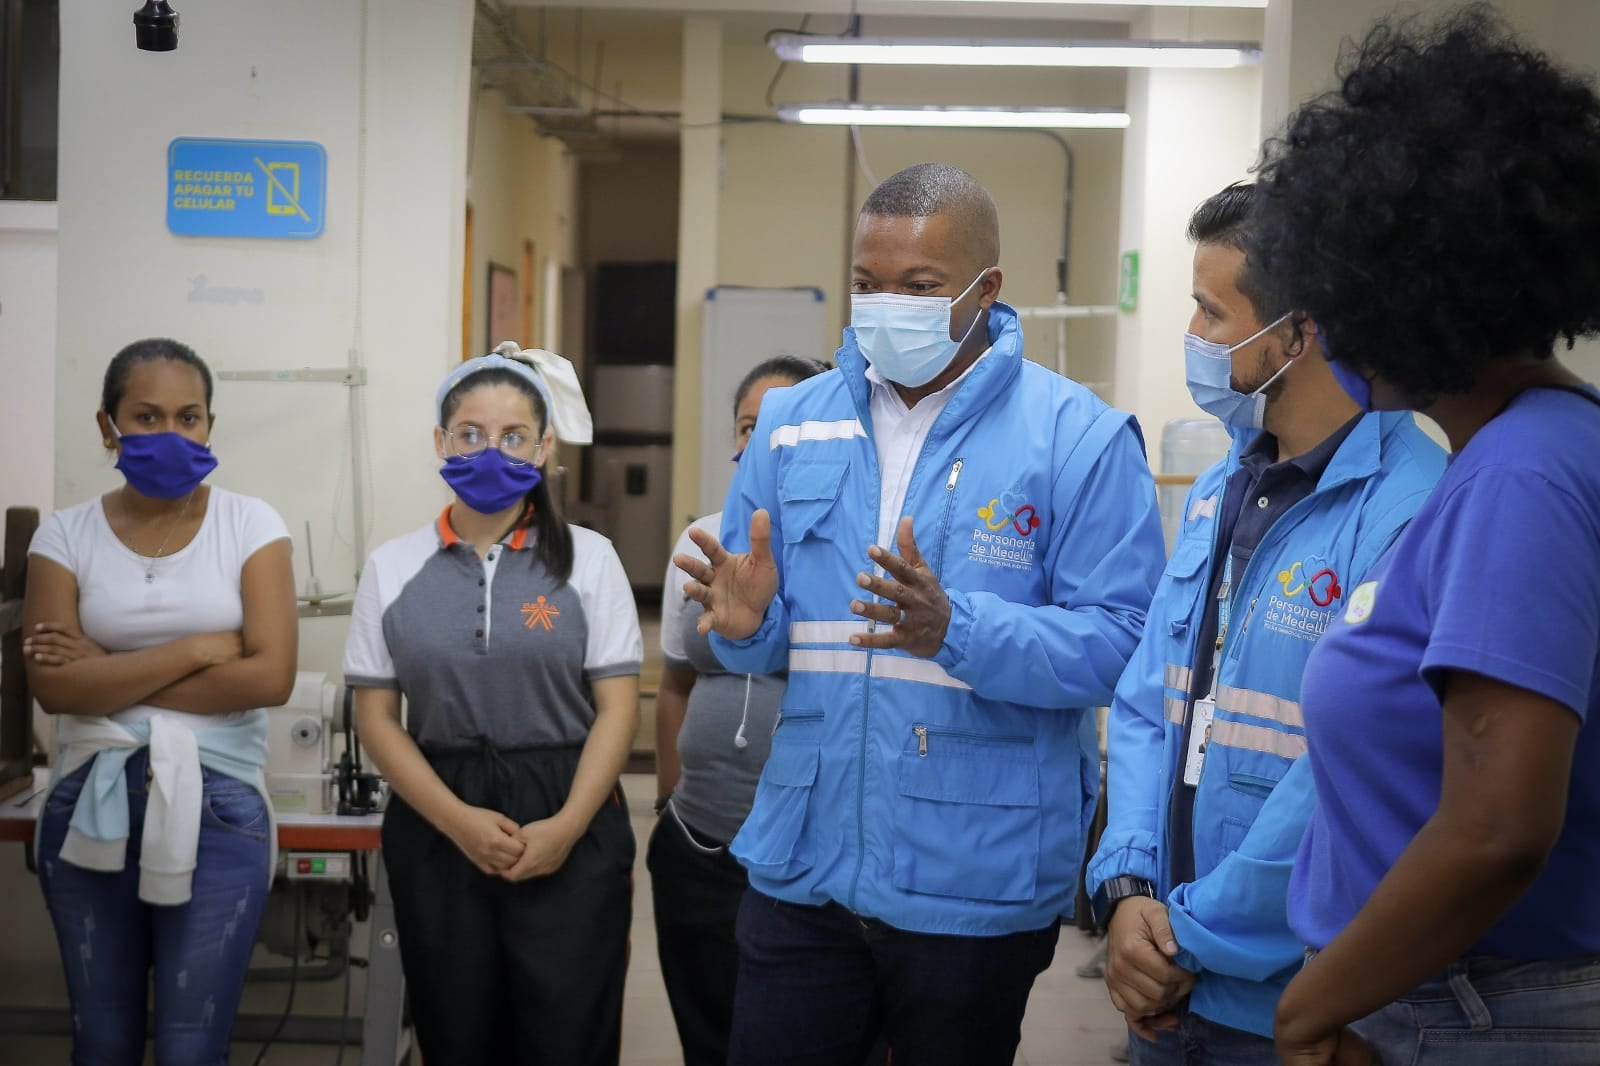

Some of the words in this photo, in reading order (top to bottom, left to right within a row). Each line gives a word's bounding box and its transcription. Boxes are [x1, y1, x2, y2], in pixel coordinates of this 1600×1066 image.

[174, 170, 254, 183] RECUERDA
[174, 184, 232, 196] APAGAR
[236, 185, 254, 197] TU
[173, 198, 235, 210] CELULAR
[973, 529, 1035, 550] Personería
[971, 542, 986, 554] de
[990, 544, 1033, 561] Medellín
[1266, 608, 1279, 620] de
[1281, 613, 1329, 634] Medellí
